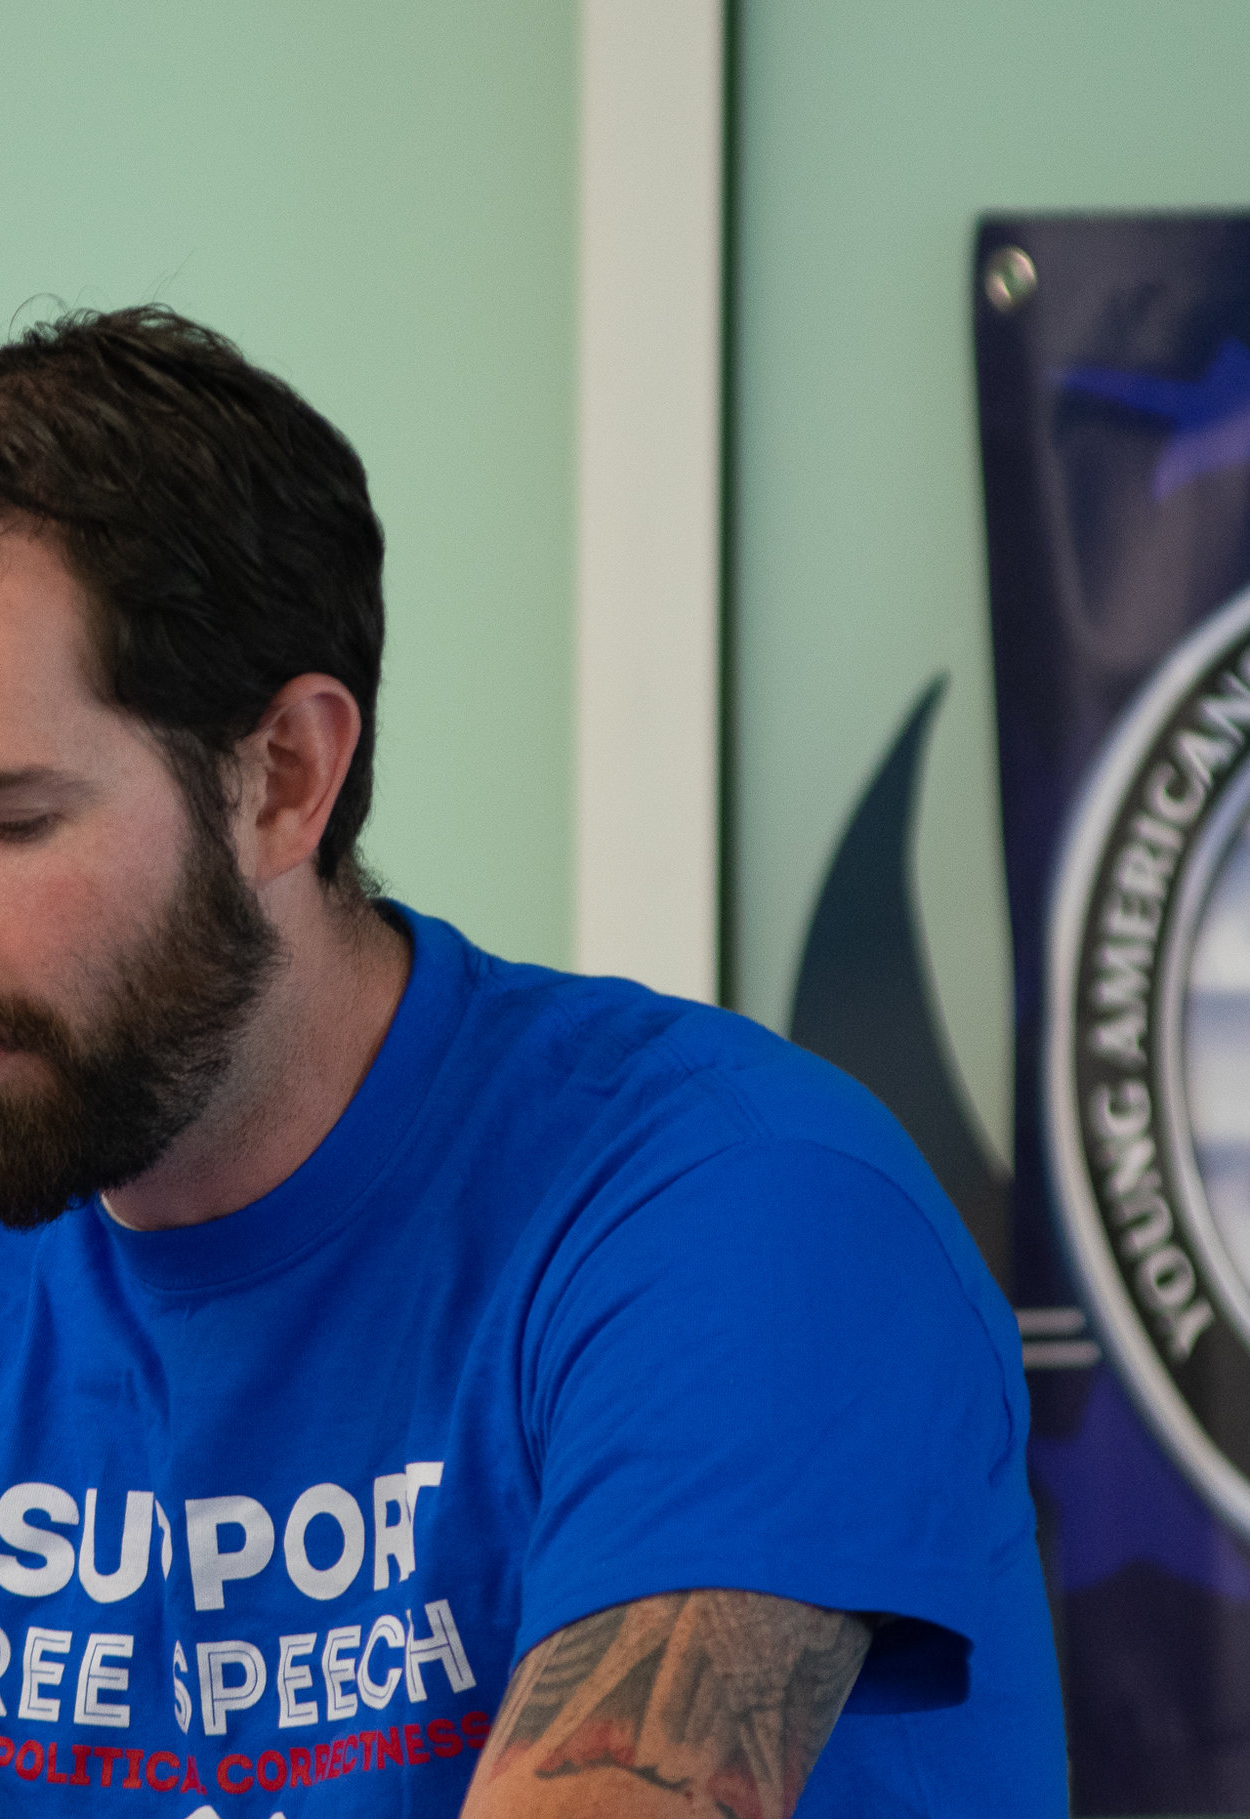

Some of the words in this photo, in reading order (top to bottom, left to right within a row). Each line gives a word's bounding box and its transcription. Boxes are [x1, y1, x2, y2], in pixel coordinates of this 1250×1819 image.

[1093, 648, 1250, 1066] AMERICAN
[1090, 1080, 1215, 1362] YOUNG
[173, 1599, 477, 1736] SPEECH
[216, 1711, 492, 1794] CORRECTNESS
